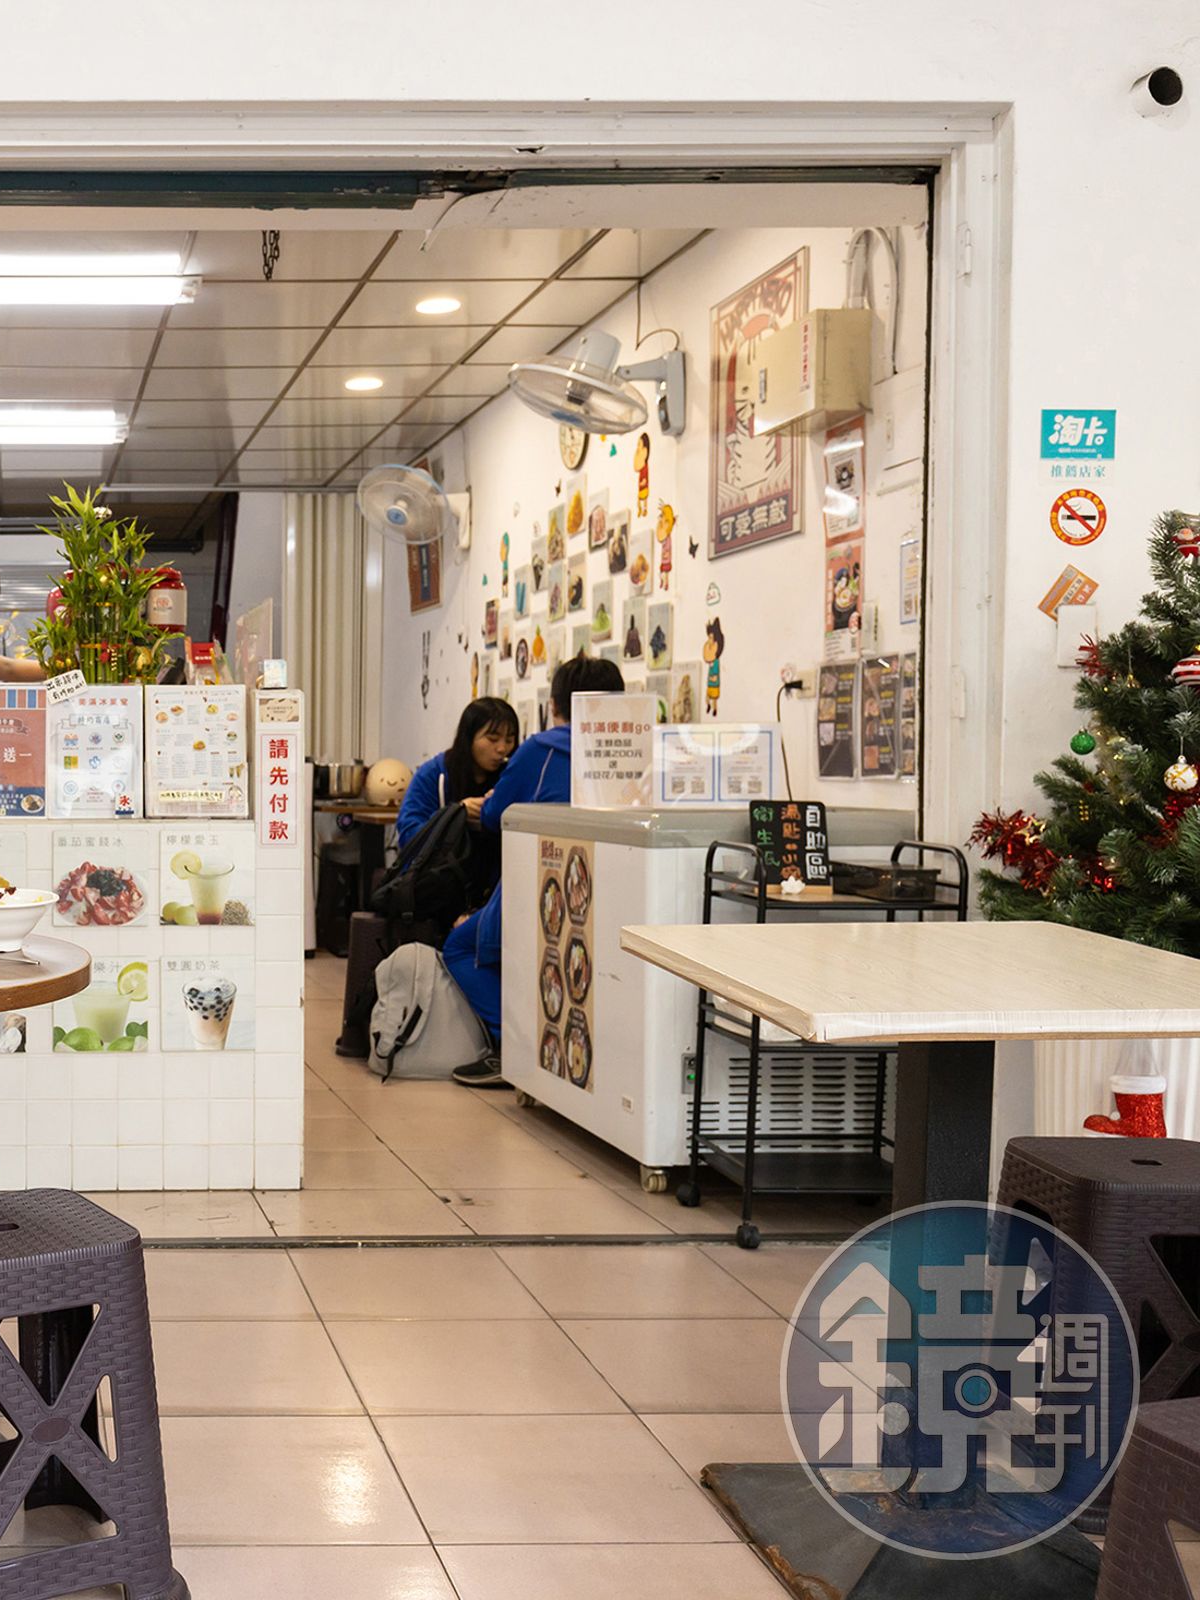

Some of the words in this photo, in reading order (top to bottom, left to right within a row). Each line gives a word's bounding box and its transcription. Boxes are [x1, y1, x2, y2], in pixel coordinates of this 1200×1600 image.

[720, 497, 787, 541] 可愛無敵
[269, 738, 289, 841] 請先付款
[166, 834, 219, 847] 檸檬愛玉
[804, 804, 828, 880] 自助區
